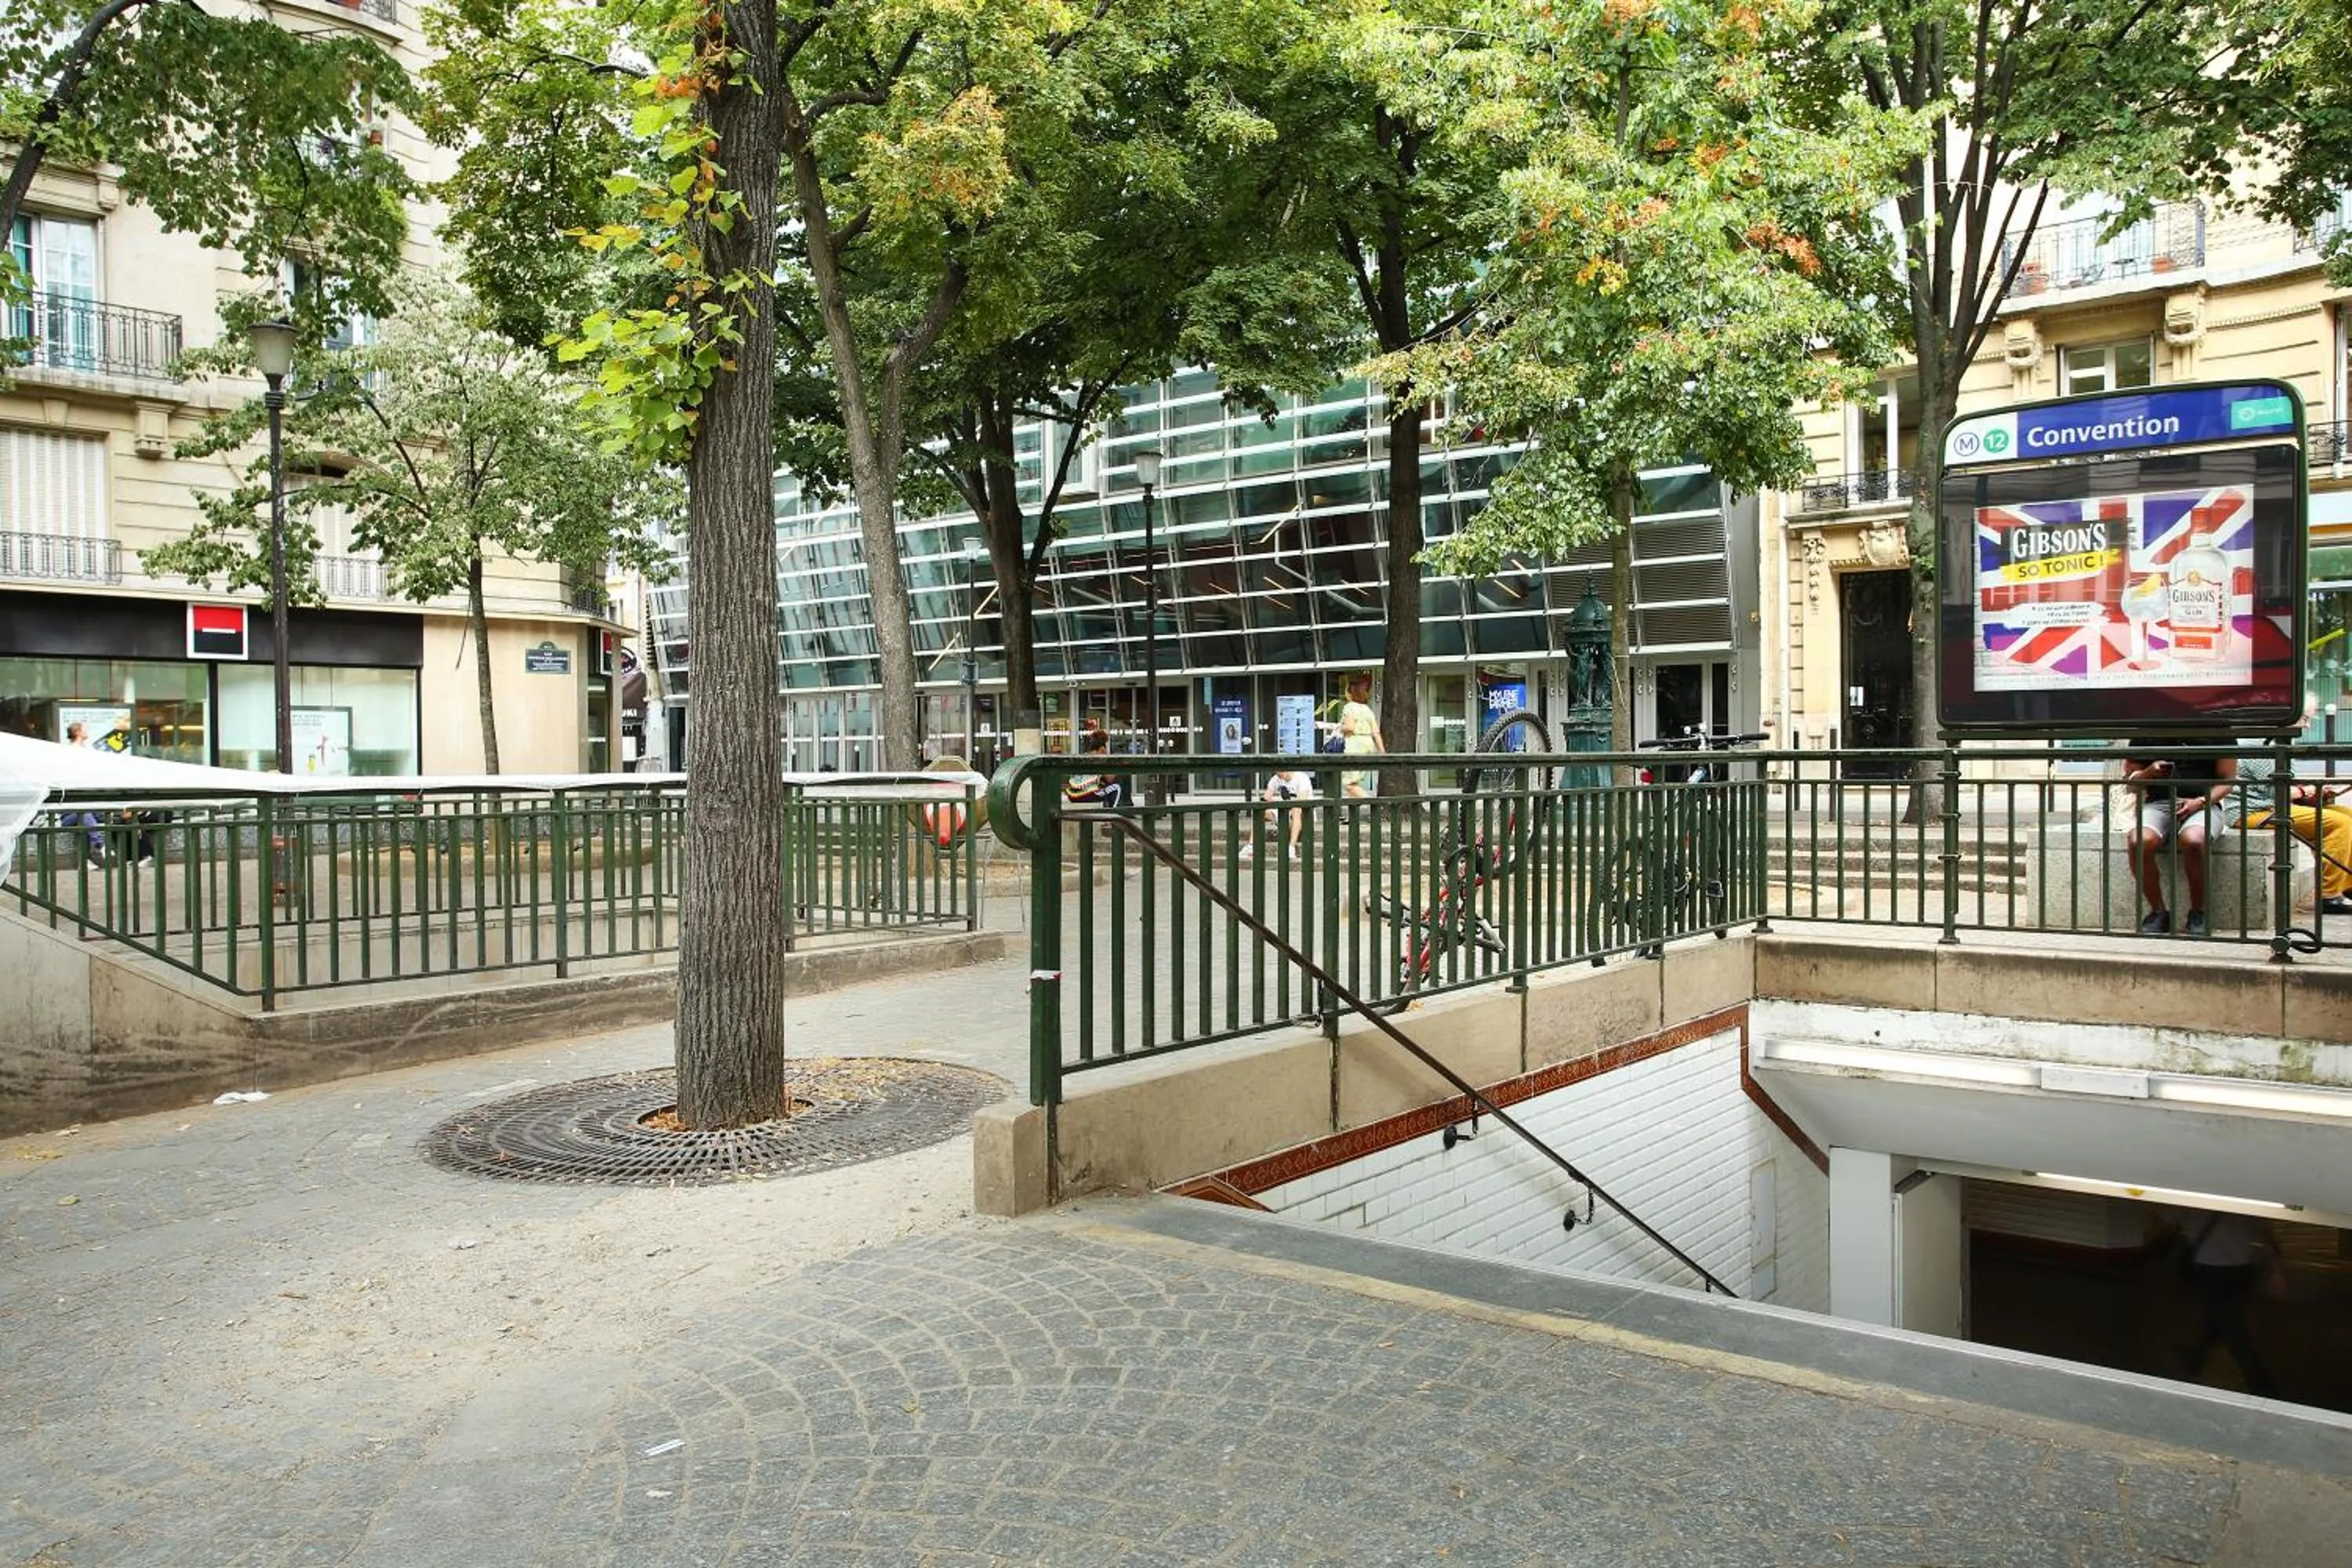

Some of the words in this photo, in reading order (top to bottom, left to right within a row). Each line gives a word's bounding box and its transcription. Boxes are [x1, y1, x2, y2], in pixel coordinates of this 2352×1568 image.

[1959, 434, 1974, 449] M
[1987, 429, 2005, 448] 12
[2027, 416, 2180, 448] Convention
[2013, 522, 2107, 558] GIBSON'S
[2018, 563, 2040, 578] SO
[2044, 556, 2096, 575] TONIC
